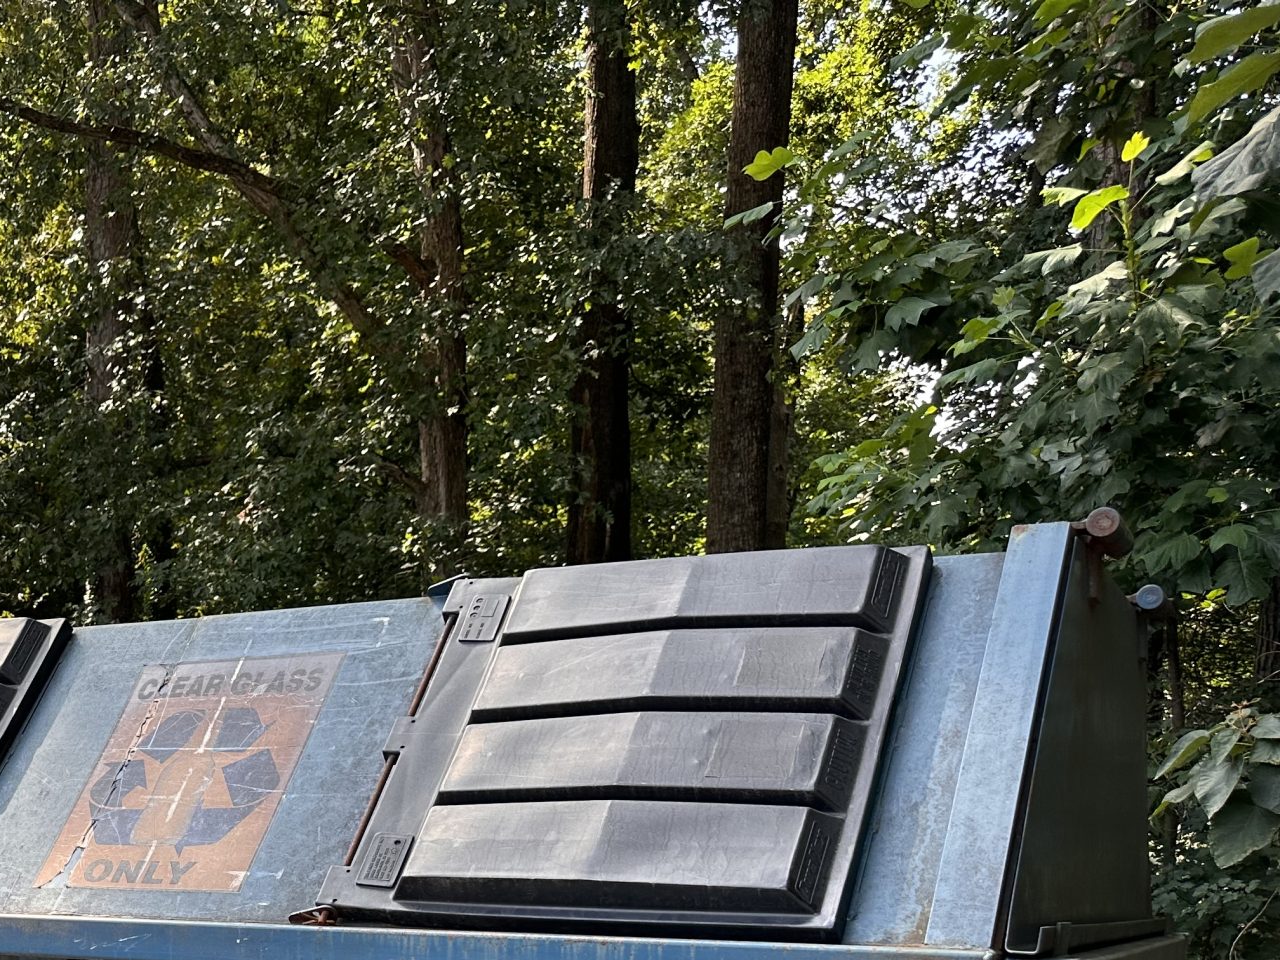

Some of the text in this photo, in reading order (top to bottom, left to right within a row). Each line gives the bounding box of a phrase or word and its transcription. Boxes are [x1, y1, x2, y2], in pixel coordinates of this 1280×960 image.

[137, 668, 324, 701] CLEAR GLASS
[83, 858, 198, 885] ONLY
